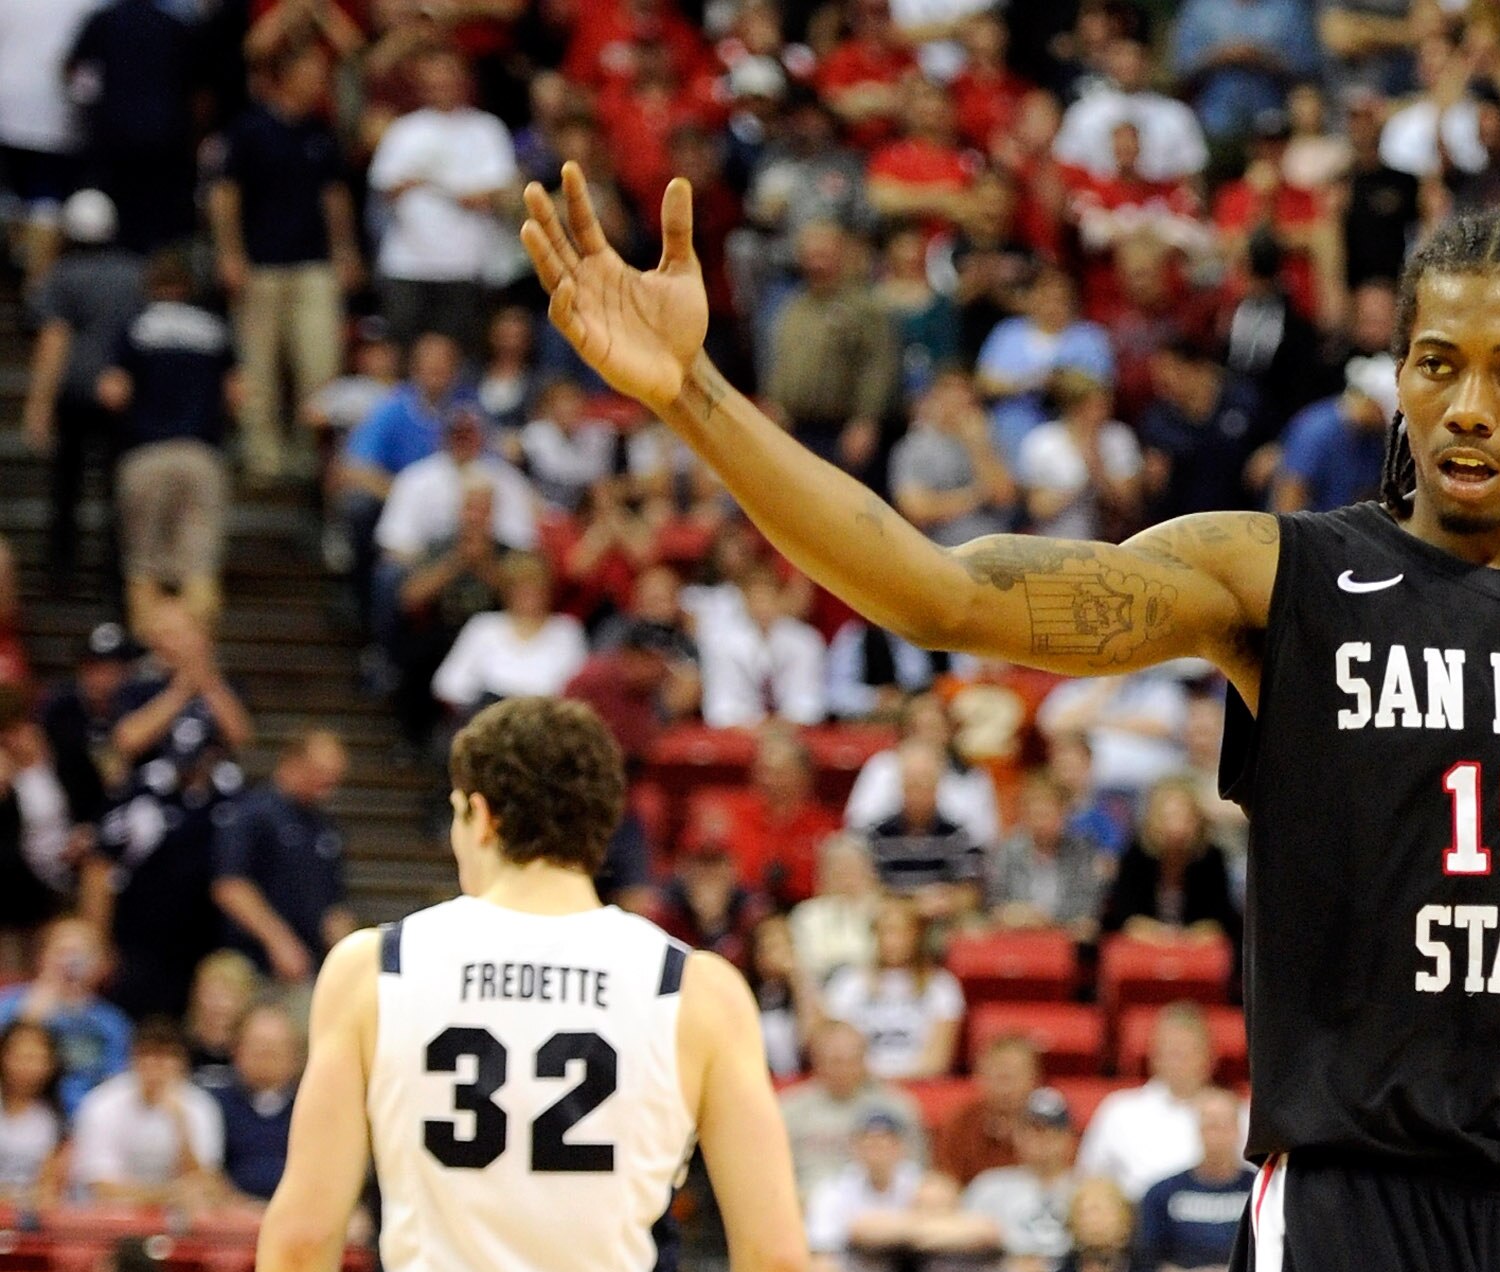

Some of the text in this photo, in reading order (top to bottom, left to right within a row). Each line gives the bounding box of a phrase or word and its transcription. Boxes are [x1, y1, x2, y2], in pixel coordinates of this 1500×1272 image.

[1335, 641, 1465, 730] SAN
[461, 963, 608, 1009] FREDETTE
[424, 1027, 617, 1172] 32
